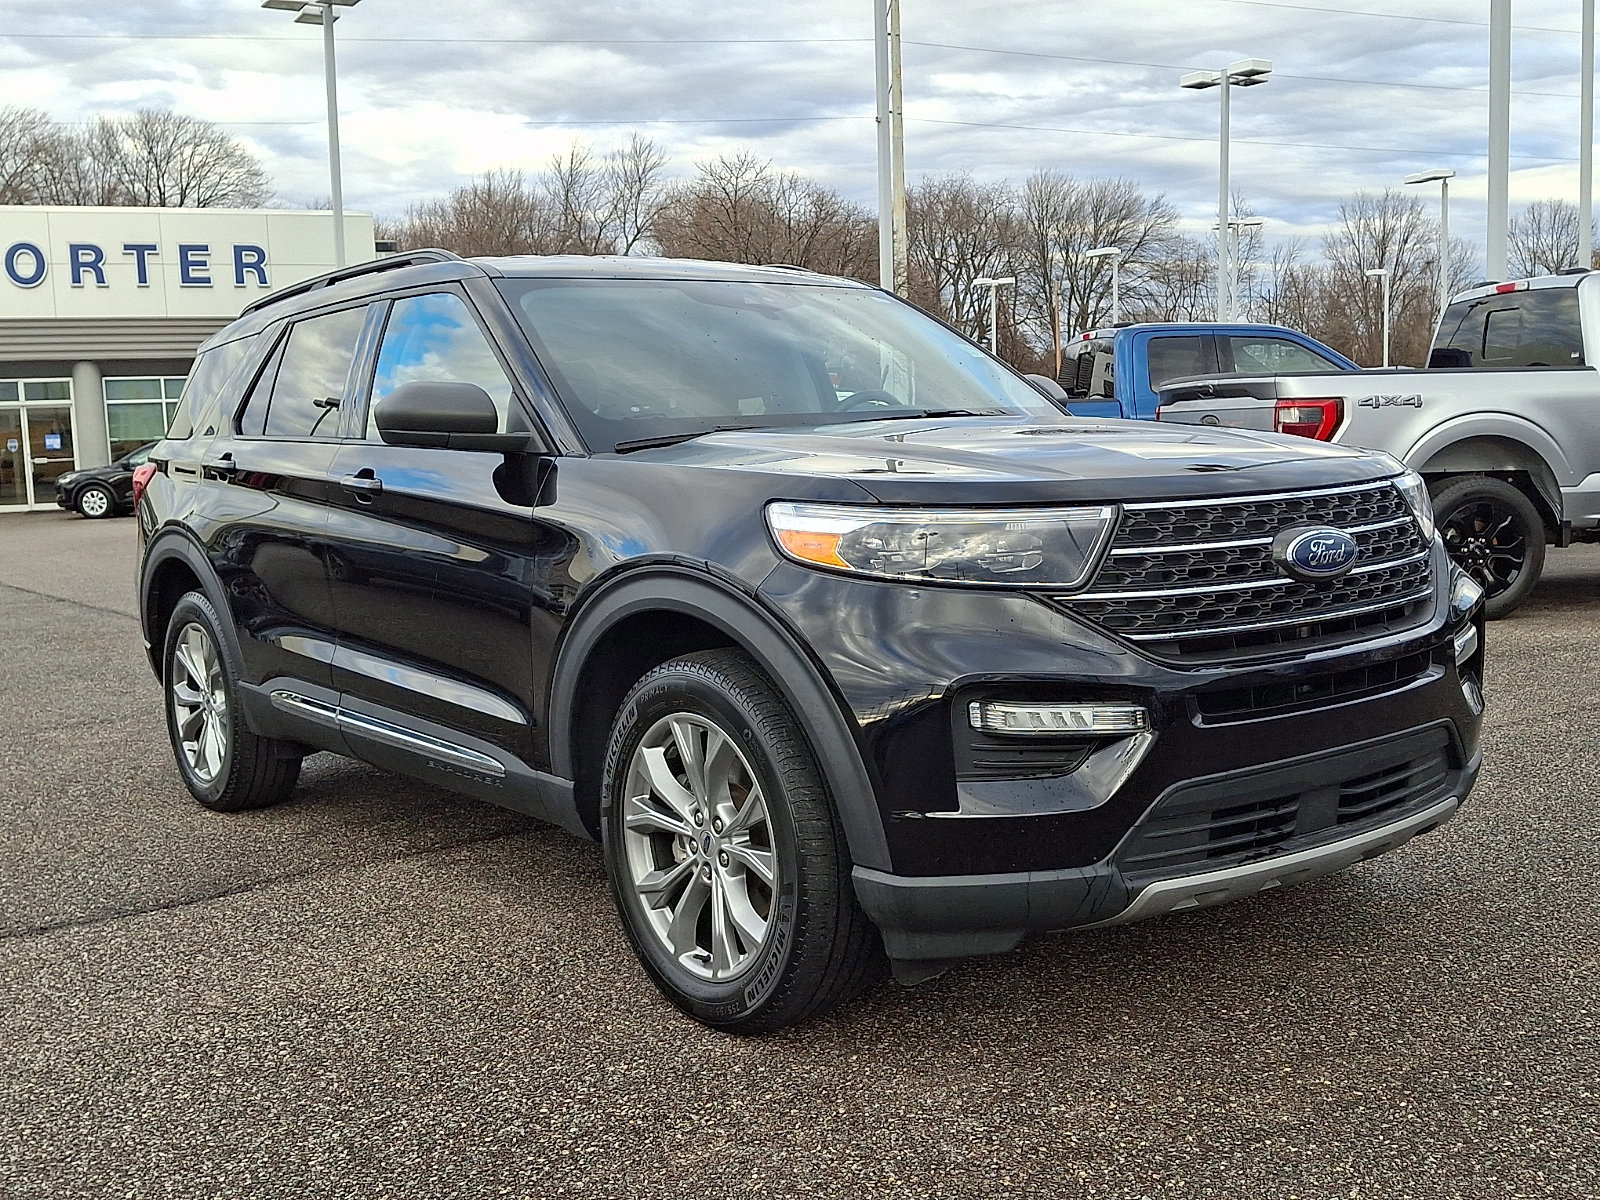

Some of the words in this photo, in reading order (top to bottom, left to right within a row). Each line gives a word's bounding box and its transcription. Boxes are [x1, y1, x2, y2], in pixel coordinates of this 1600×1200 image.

[3, 241, 270, 288] ORTER
[1309, 539, 1346, 566] Ford
[640, 685, 669, 703] PRIMACY
[605, 705, 636, 778] MICHELIN
[747, 928, 786, 1002] MICHELIN
